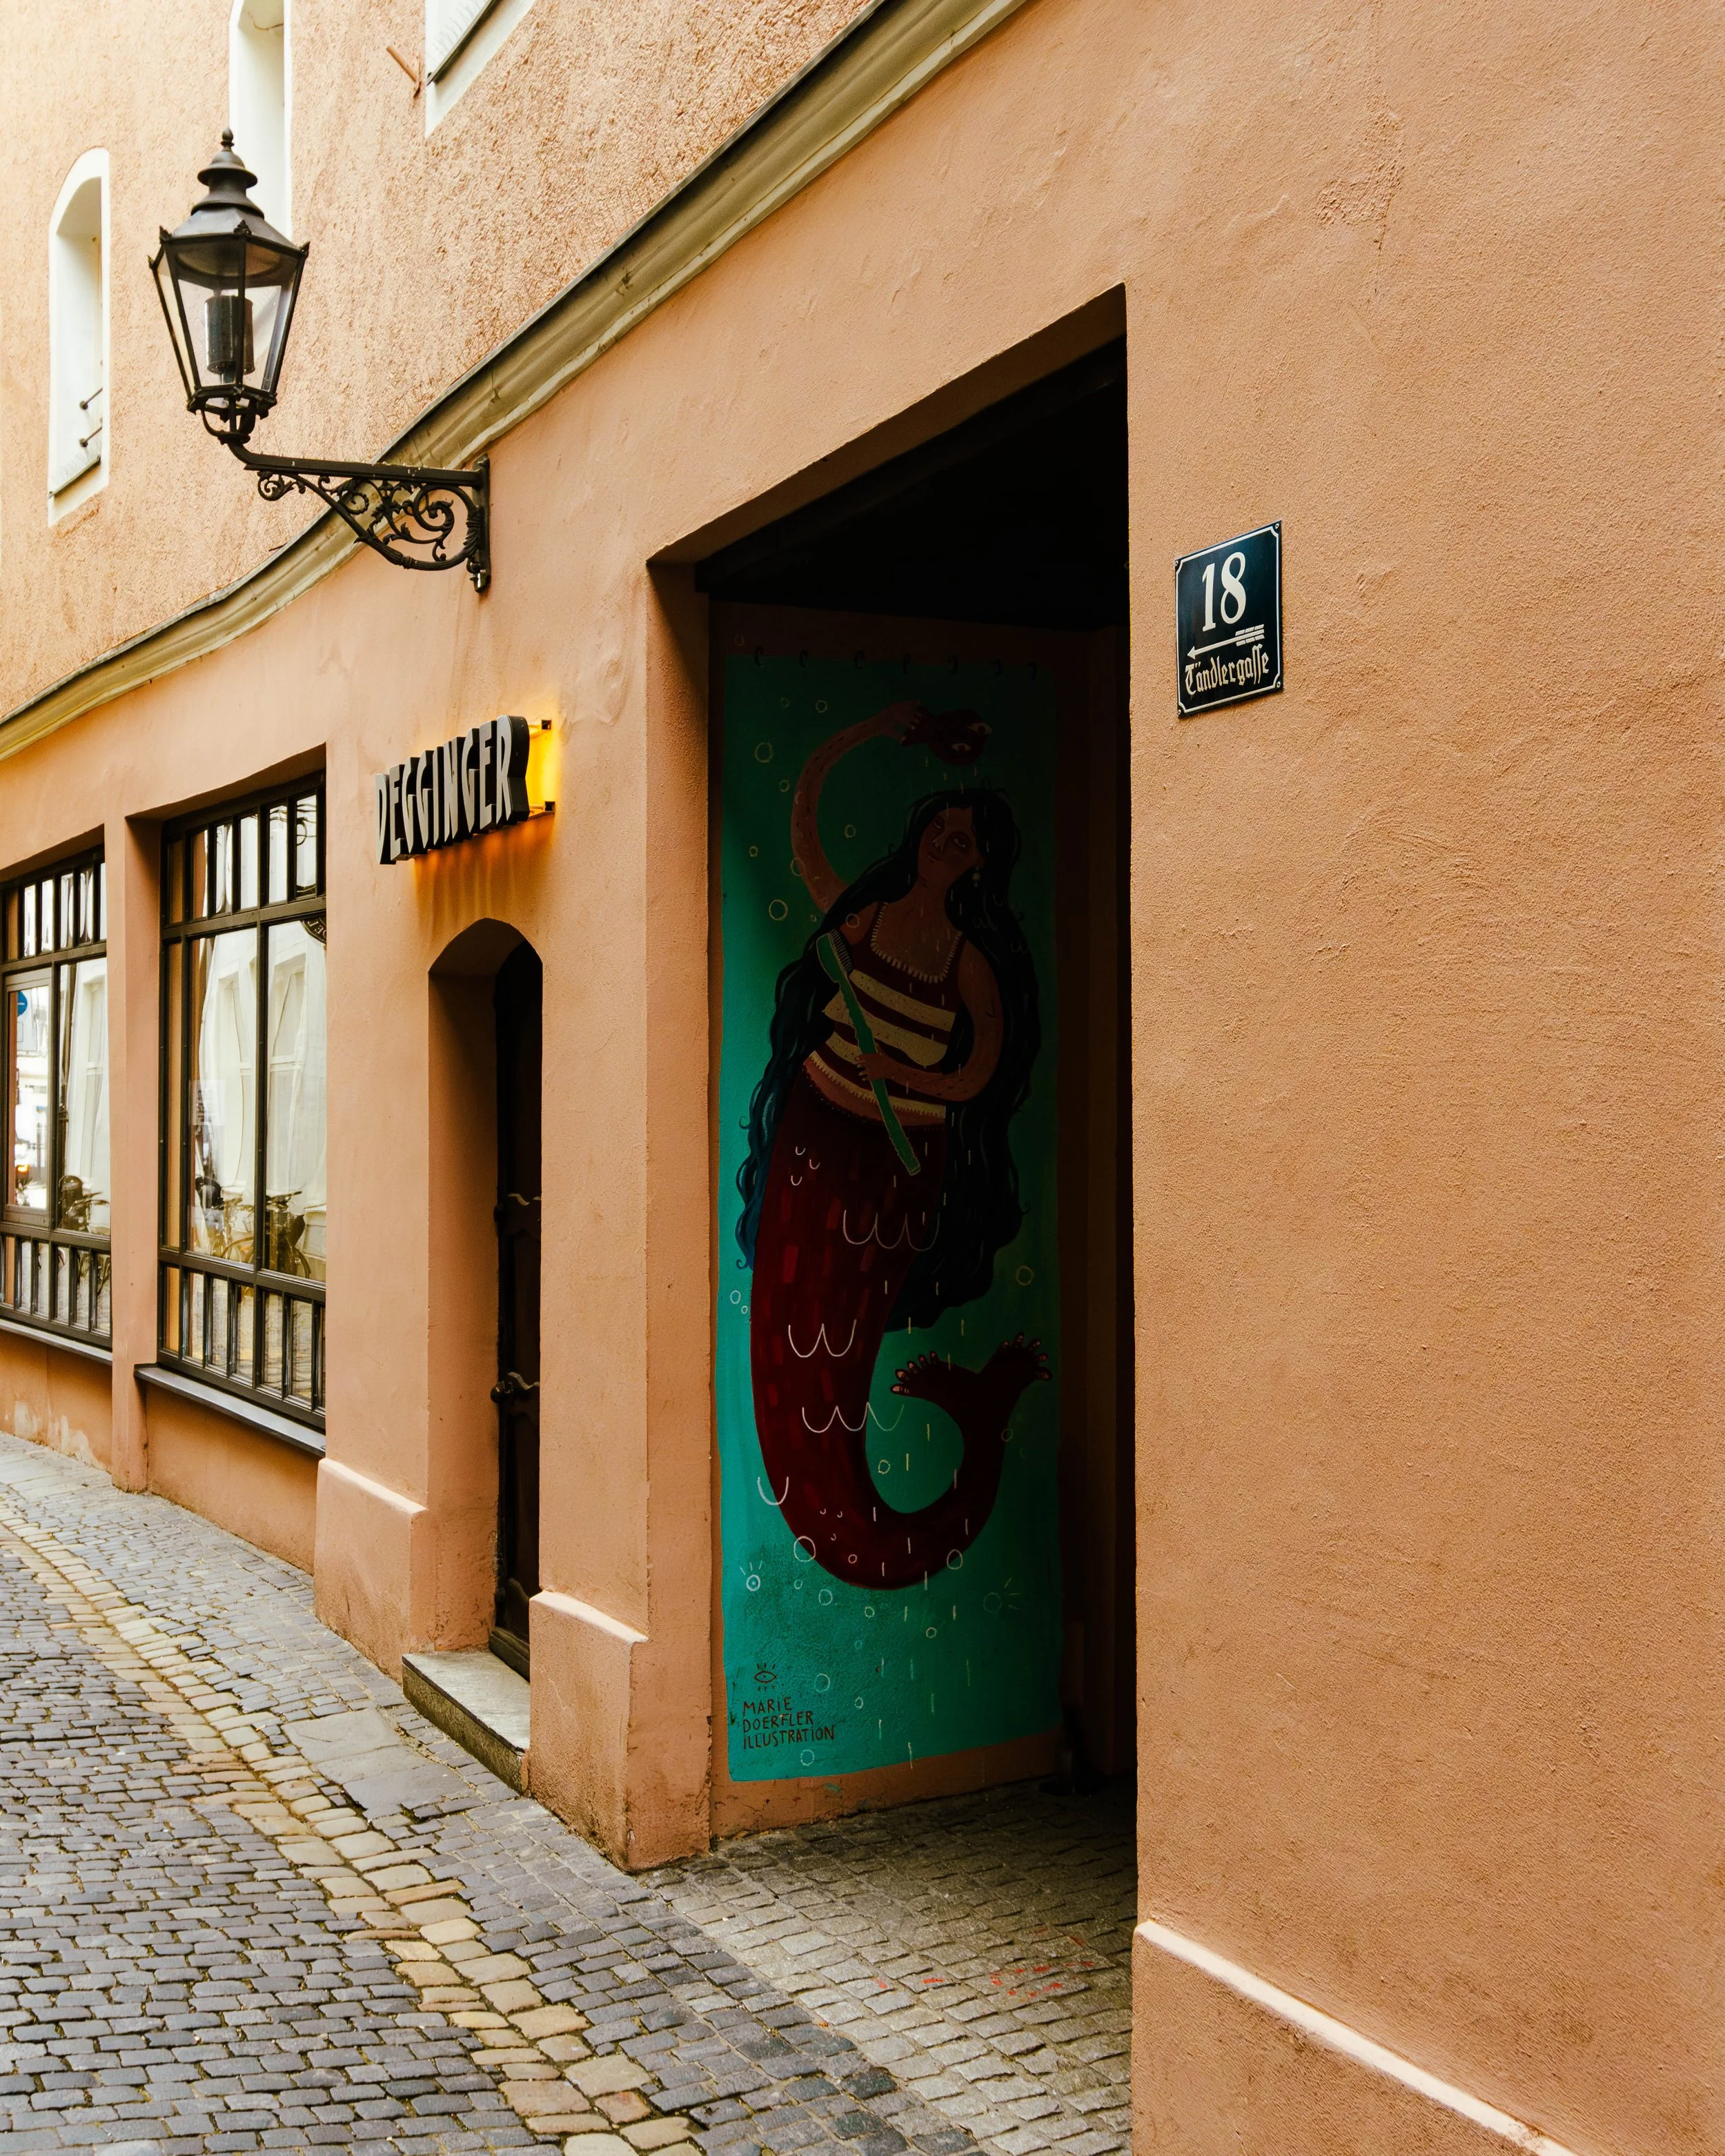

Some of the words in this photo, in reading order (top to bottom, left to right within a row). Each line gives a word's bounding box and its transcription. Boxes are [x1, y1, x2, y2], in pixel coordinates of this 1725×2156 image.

[1202, 552, 1246, 632] 18
[375, 715, 530, 864] DEGGINGER
[743, 1697, 792, 1717] MARIE
[743, 1711, 814, 1733] DOERFLER
[743, 1725, 835, 1750] ILLUSTRATION
